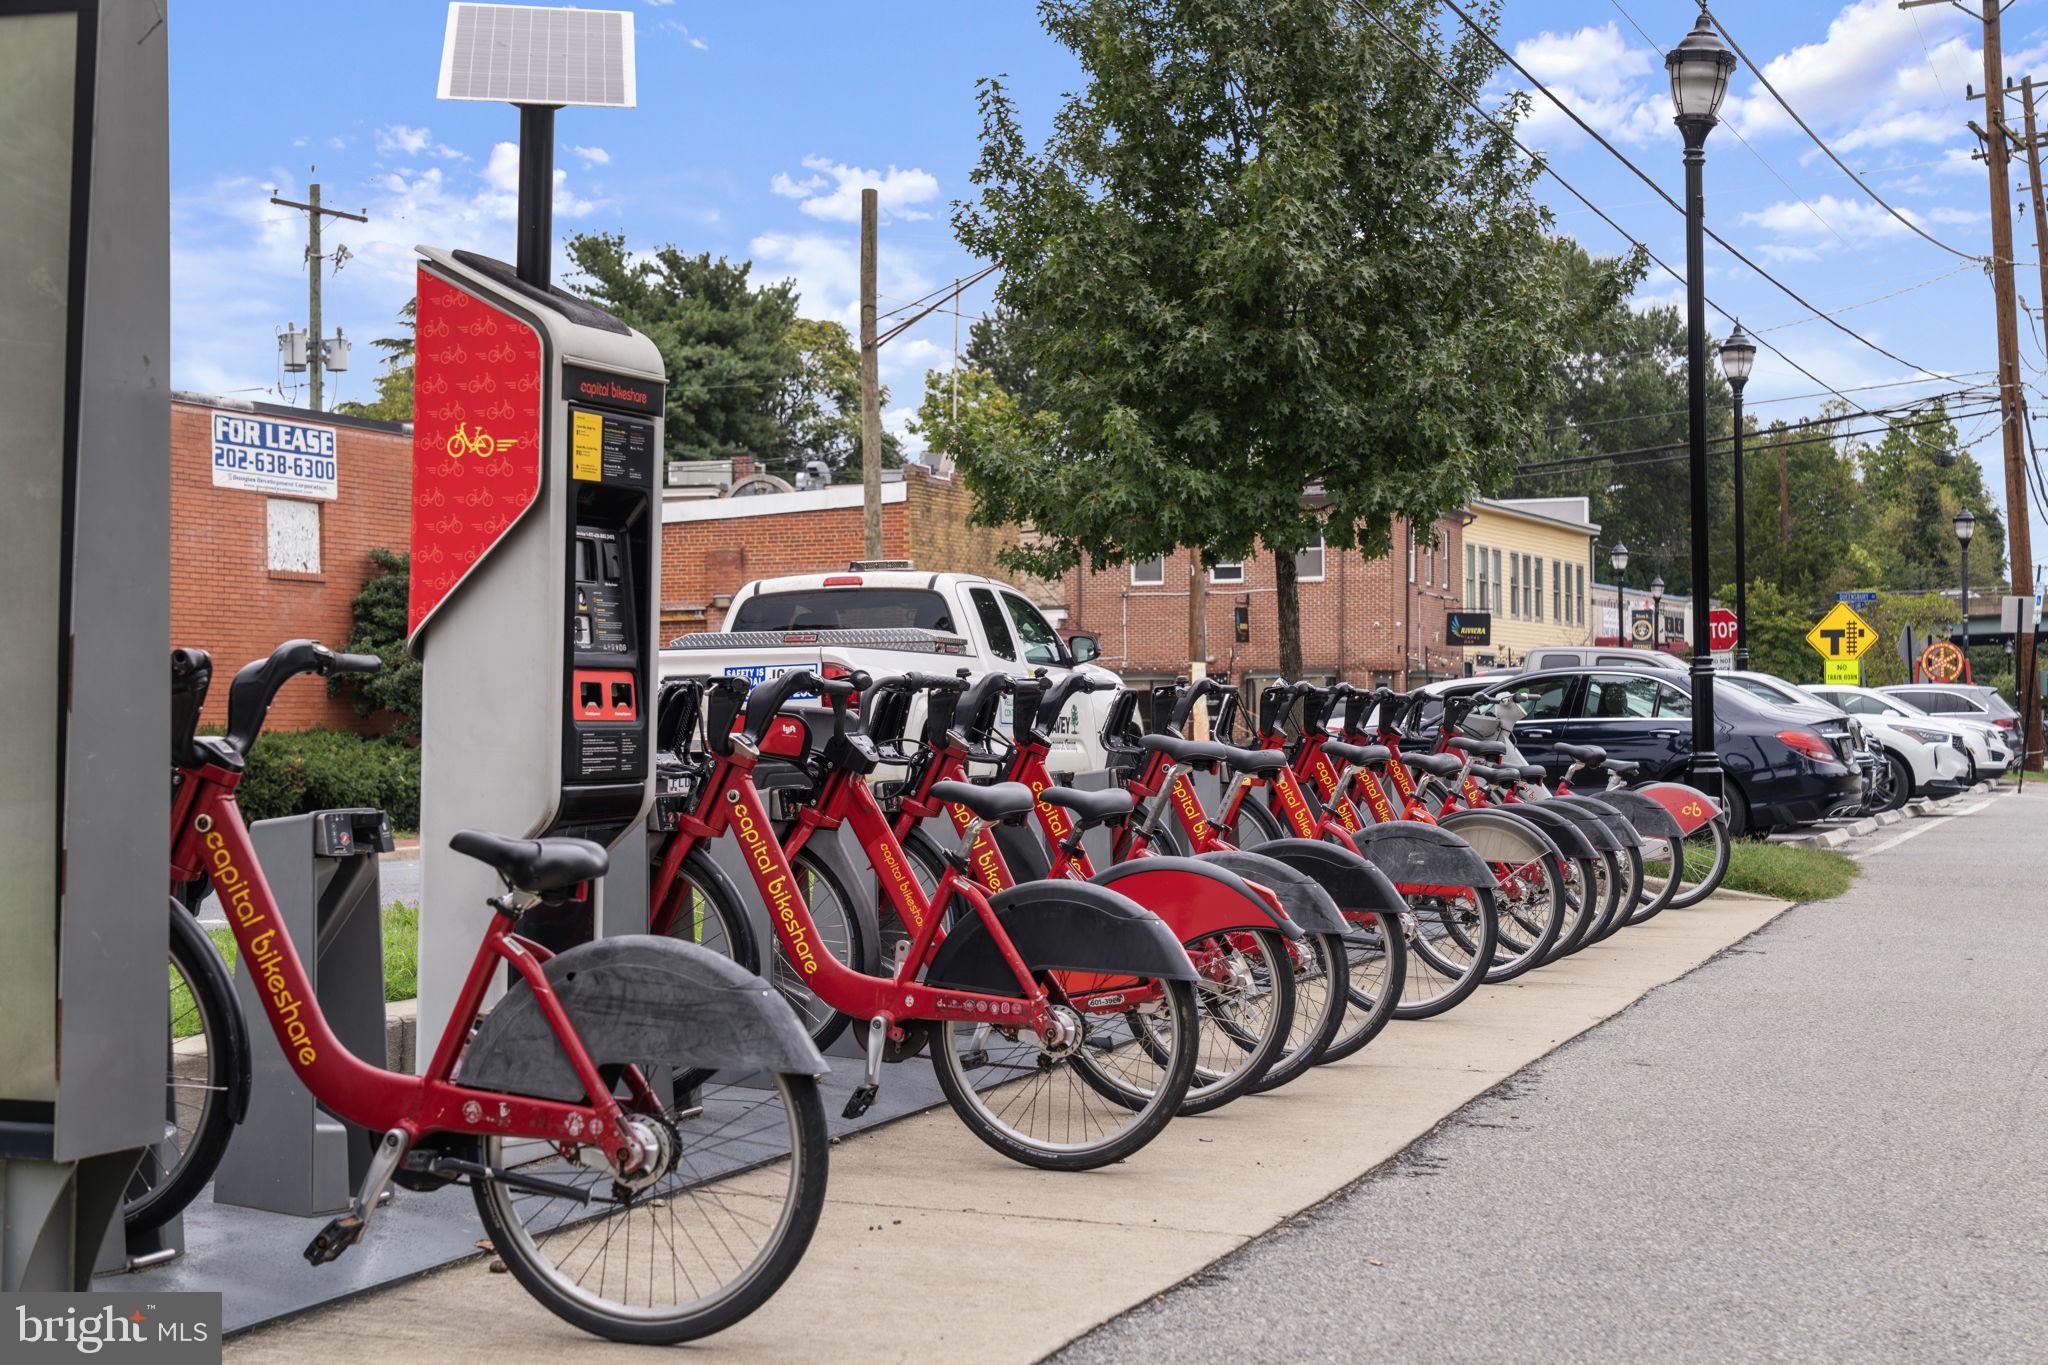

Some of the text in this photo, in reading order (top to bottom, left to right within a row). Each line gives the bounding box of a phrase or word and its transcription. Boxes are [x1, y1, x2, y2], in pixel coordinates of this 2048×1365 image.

[580, 381, 647, 405] capital bikeshare
[216, 416, 333, 456] FOR LEASE
[215, 446, 335, 480] 202-638-6300
[1461, 627, 1486, 635] RIVIERA
[1710, 621, 1738, 639] TOP
[726, 668, 754, 677] SAFETY
[756, 668, 764, 677] IS
[1276, 781, 1300, 808] pital
[1391, 760, 1411, 796] capita
[1173, 780, 1200, 819] apital
[1338, 802, 1357, 834] bikes
[734, 803, 818, 974] capital bikeshare
[881, 843, 923, 927] capital bikesha
[206, 831, 317, 1066] capital bikeshare
